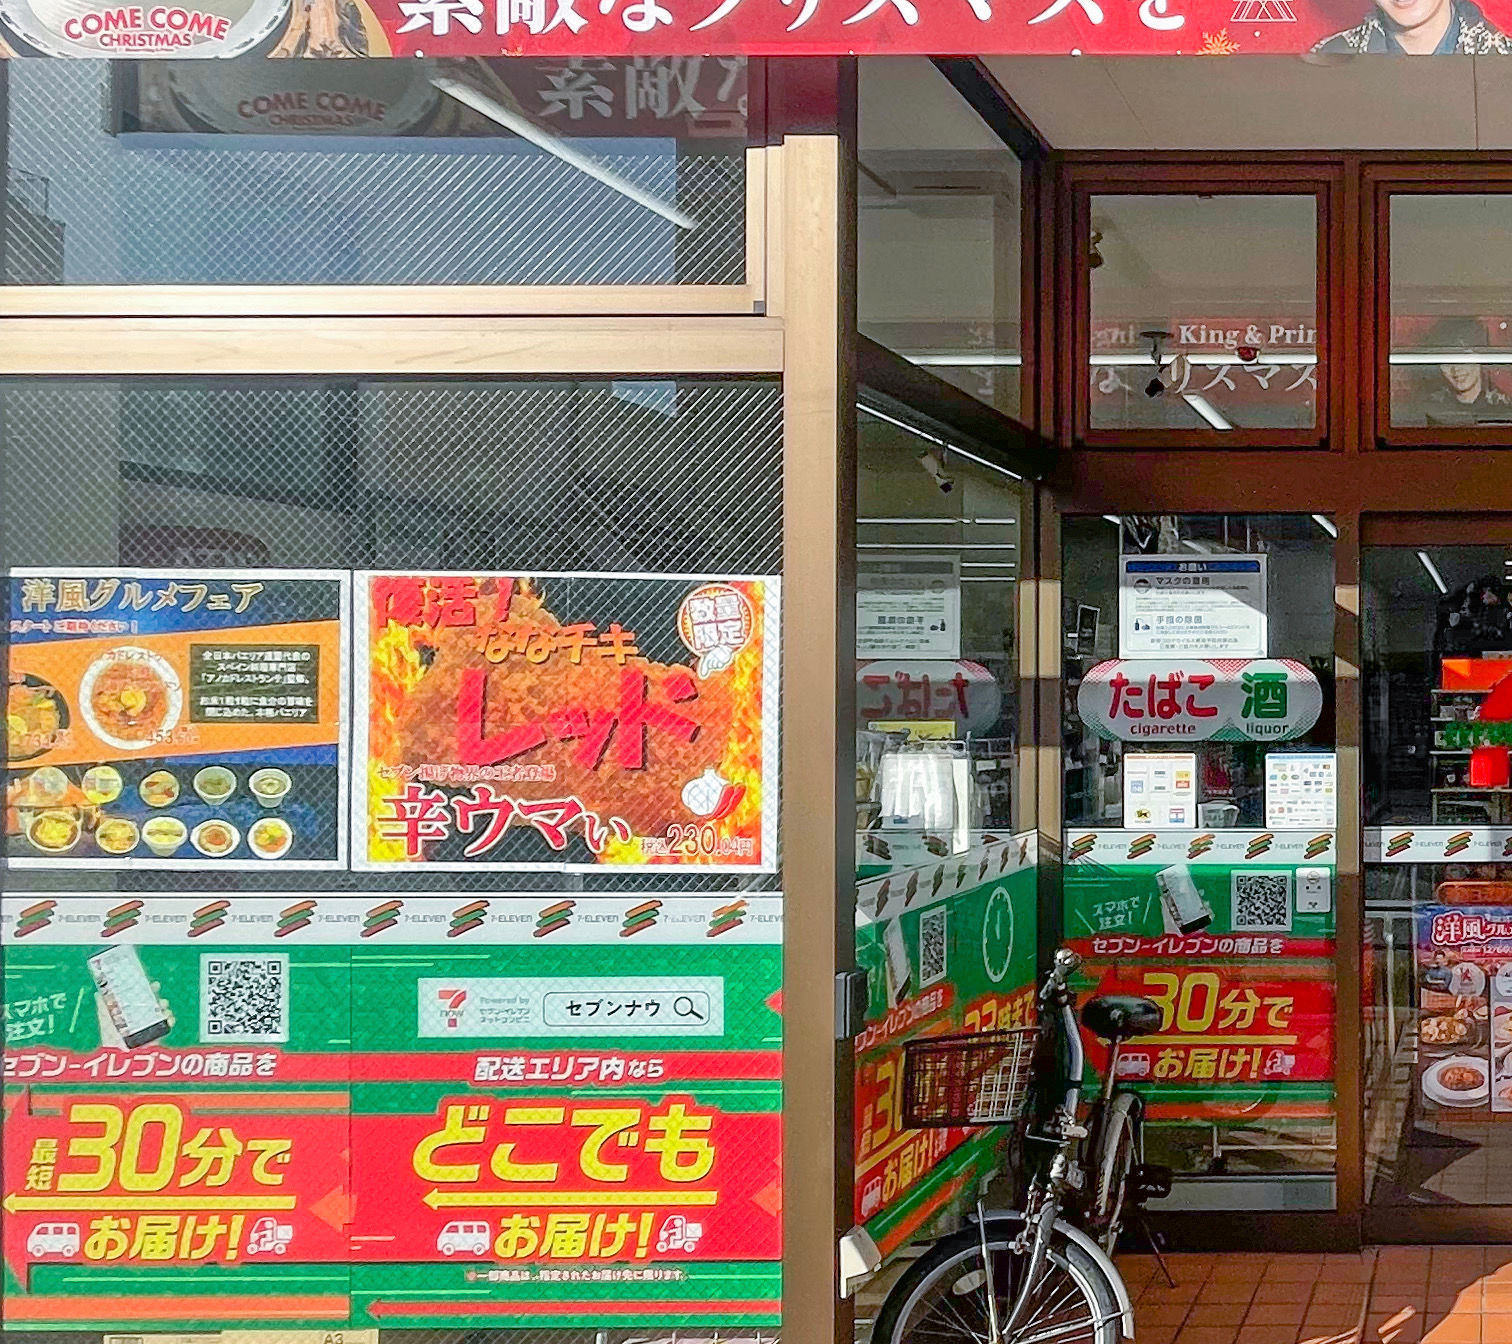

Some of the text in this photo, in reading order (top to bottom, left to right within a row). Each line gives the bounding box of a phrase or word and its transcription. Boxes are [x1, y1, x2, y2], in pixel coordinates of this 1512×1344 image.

[64, 8, 231, 41] COME COME
[99, 33, 193, 47] CHRISTMAS
[1179, 324, 1240, 350] King
[21, 577, 265, 614] 洋風グルメフェア
[476, 622, 640, 665] ななチキ
[1108, 670, 1289, 720] たばこ 酒
[457, 667, 701, 772] レッド
[1129, 723, 1290, 737] cigarette liquor
[565, 998, 662, 1018] セブンナウ
[1143, 971, 1295, 1033] 30分で
[473, 1056, 665, 1082] 配送エリア内なら
[1152, 1047, 1263, 1079] お届け!
[57, 1103, 293, 1192] 30分で
[412, 1103, 716, 1183] どこでも
[84, 1214, 246, 1261] お届け!
[493, 1212, 655, 1259] お届け!
